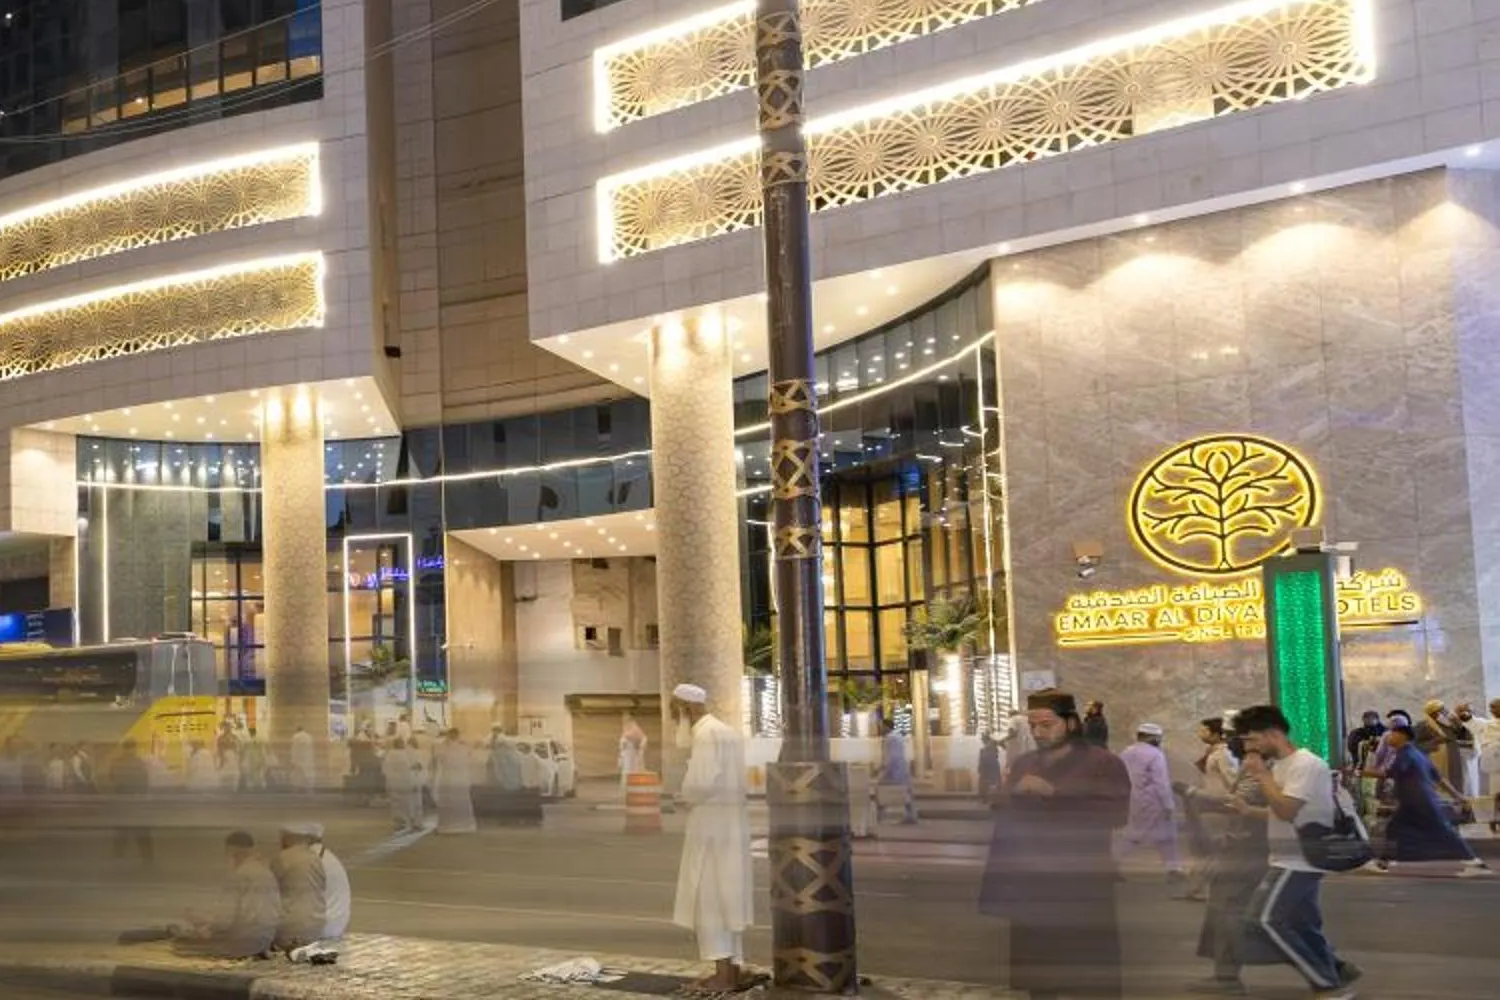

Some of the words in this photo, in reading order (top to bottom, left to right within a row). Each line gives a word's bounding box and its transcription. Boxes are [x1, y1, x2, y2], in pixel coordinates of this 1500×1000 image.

[1172, 580, 1258, 603] الضيافة
[1059, 611, 1145, 631] EMAAR
[1159, 608, 1186, 626] AL
[1197, 604, 1260, 623] DIYA
[1337, 595, 1416, 615] OTELS
